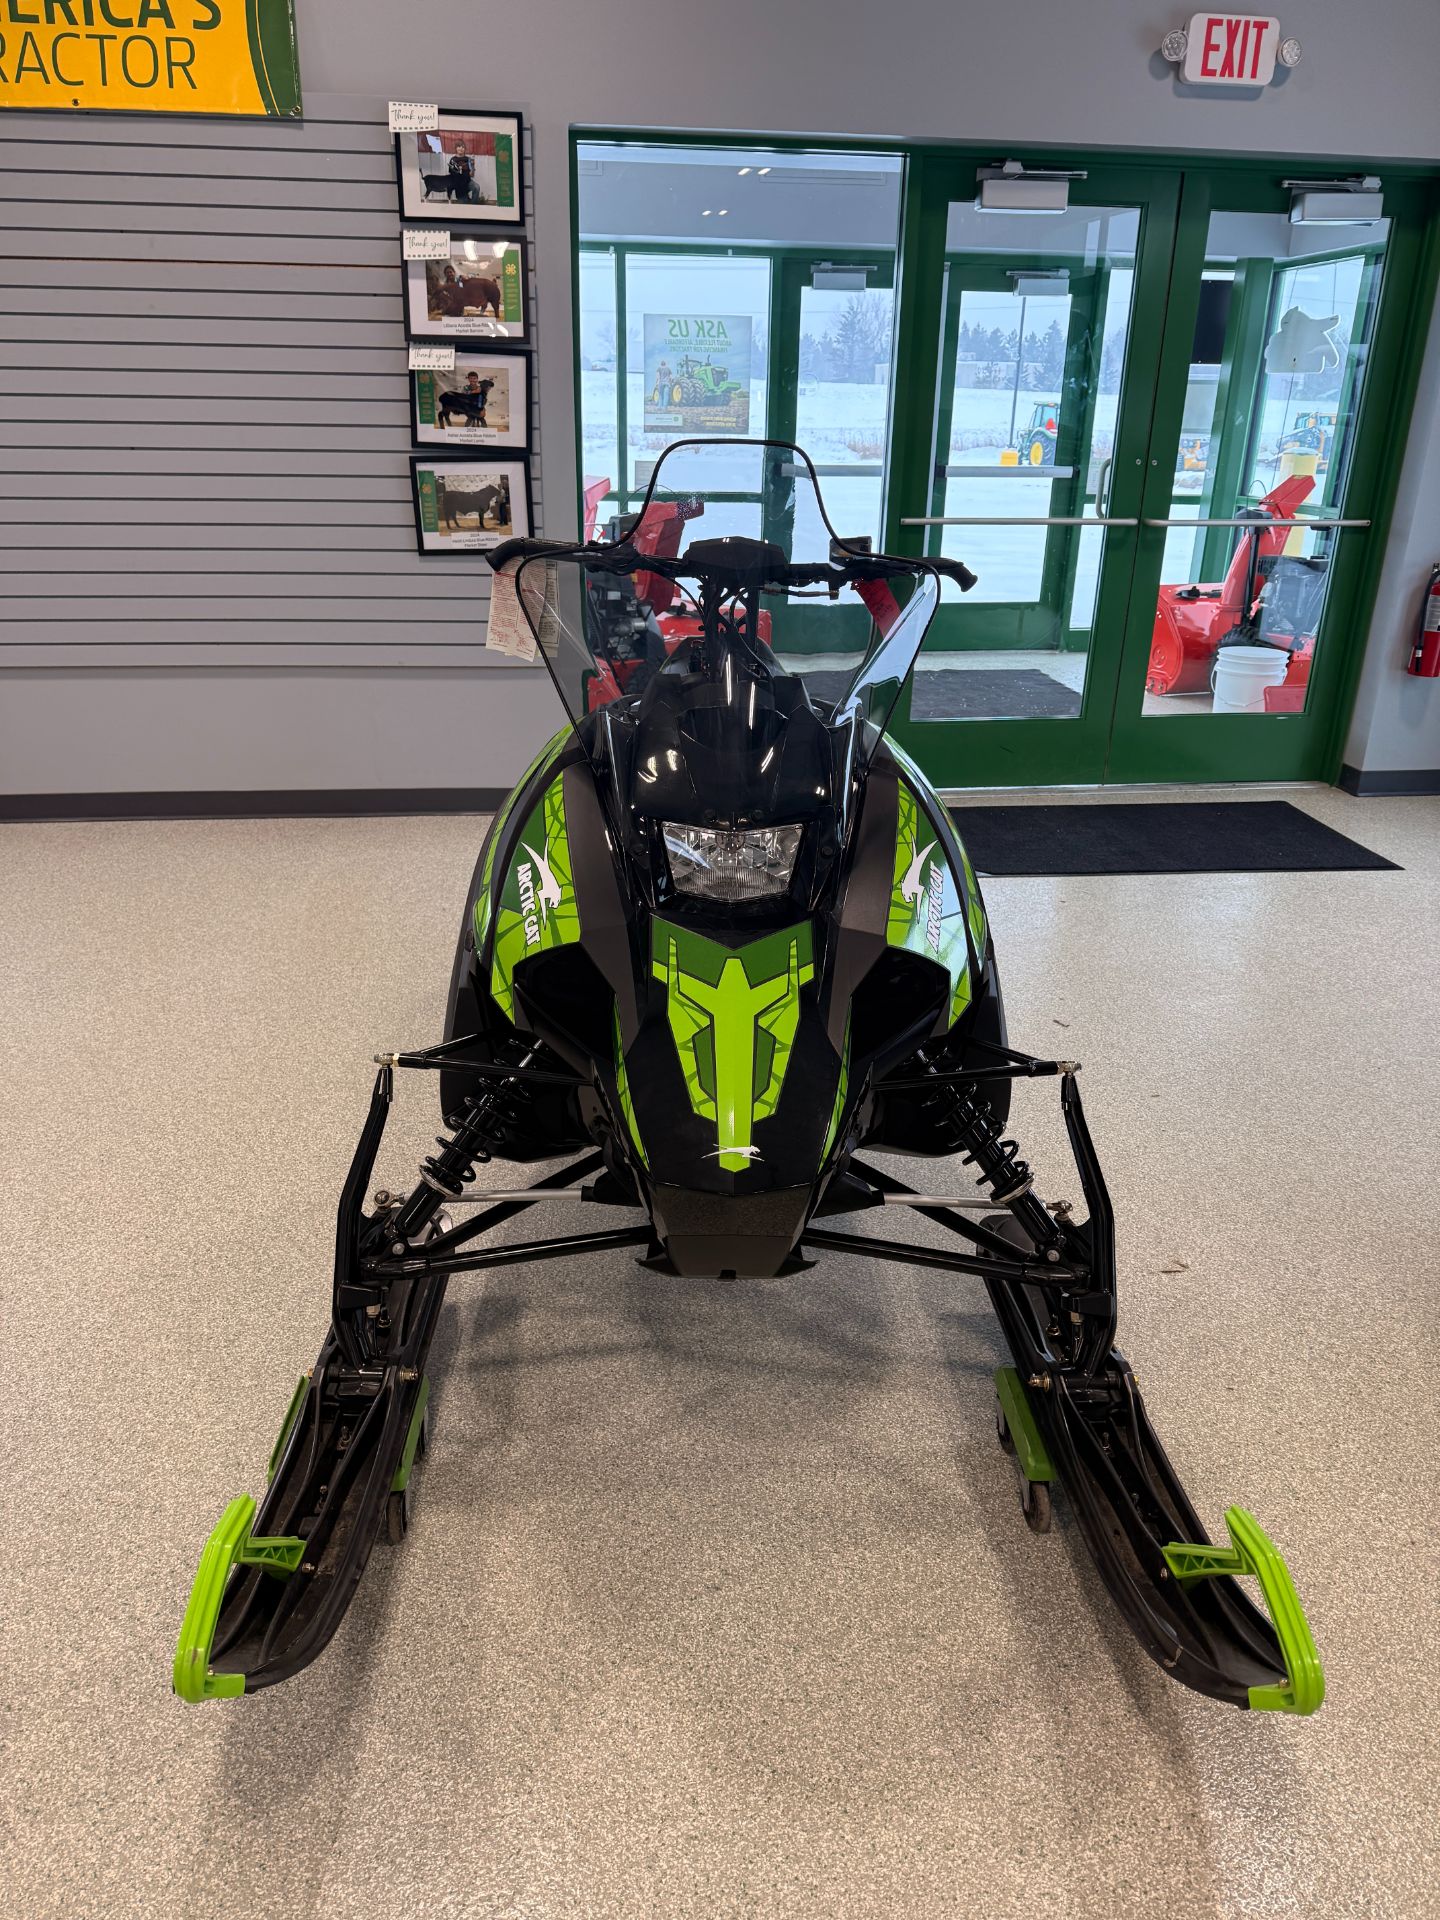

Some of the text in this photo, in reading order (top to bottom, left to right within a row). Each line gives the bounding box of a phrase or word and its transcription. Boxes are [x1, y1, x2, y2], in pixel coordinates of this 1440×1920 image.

[0, 31, 198, 90] ACTOR
[1200, 17, 1269, 80] EXIT
[390, 109, 415, 122] Thank
[405, 236, 428, 249] Thank
[517, 862, 541, 946] ARCTIC CAT
[926, 860, 944, 954] ARCTIC CAT
